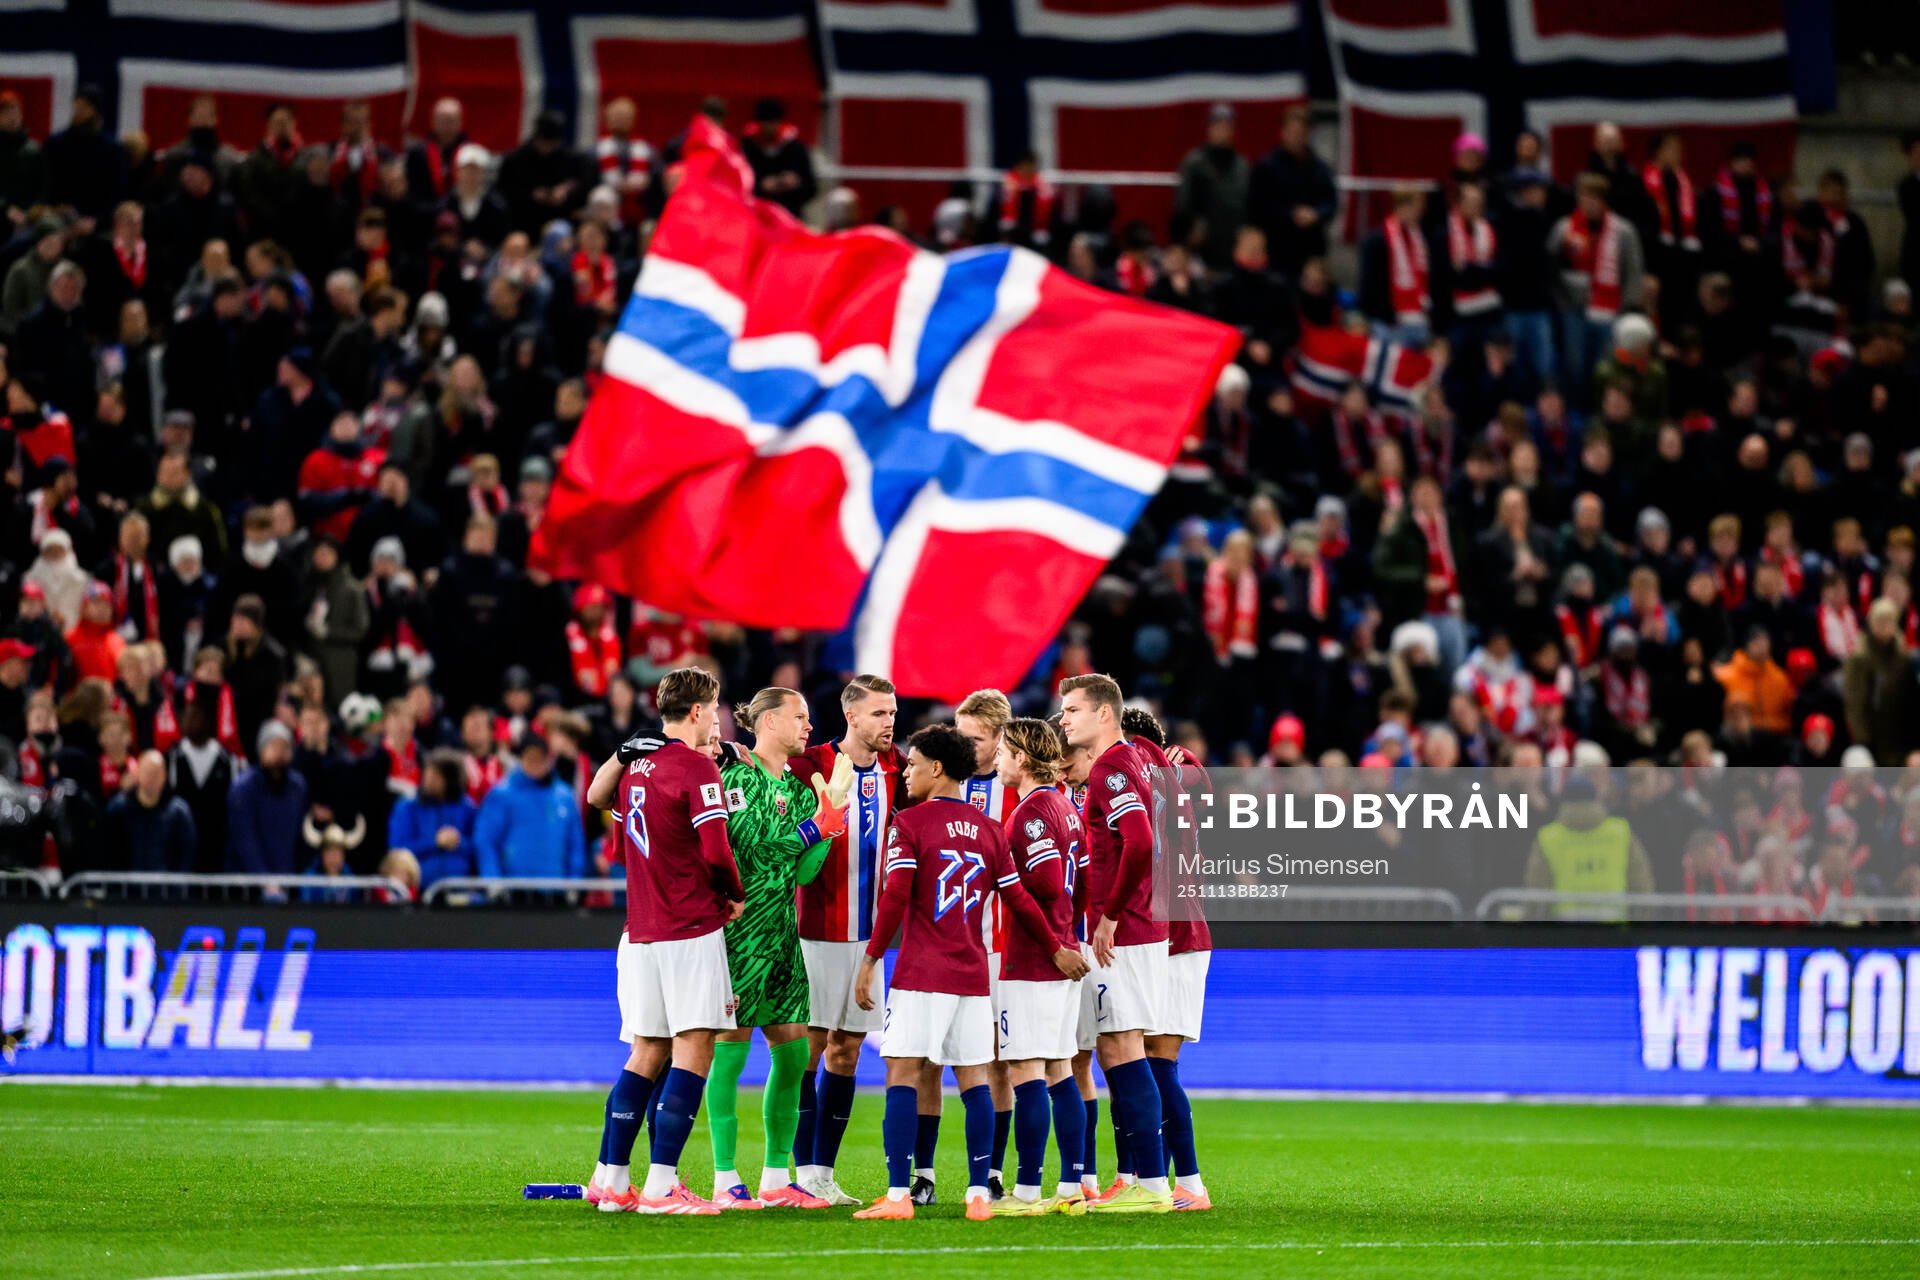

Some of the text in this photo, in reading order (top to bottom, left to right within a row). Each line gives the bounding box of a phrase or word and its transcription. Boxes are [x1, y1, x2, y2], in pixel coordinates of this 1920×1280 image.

[629, 758, 656, 778] BERGE
[626, 786, 649, 859] 8
[946, 821, 979, 840] BOBB
[934, 849, 986, 924] 22
[1097, 984, 1107, 1011] 7
[1001, 1010, 1009, 1036] 6
